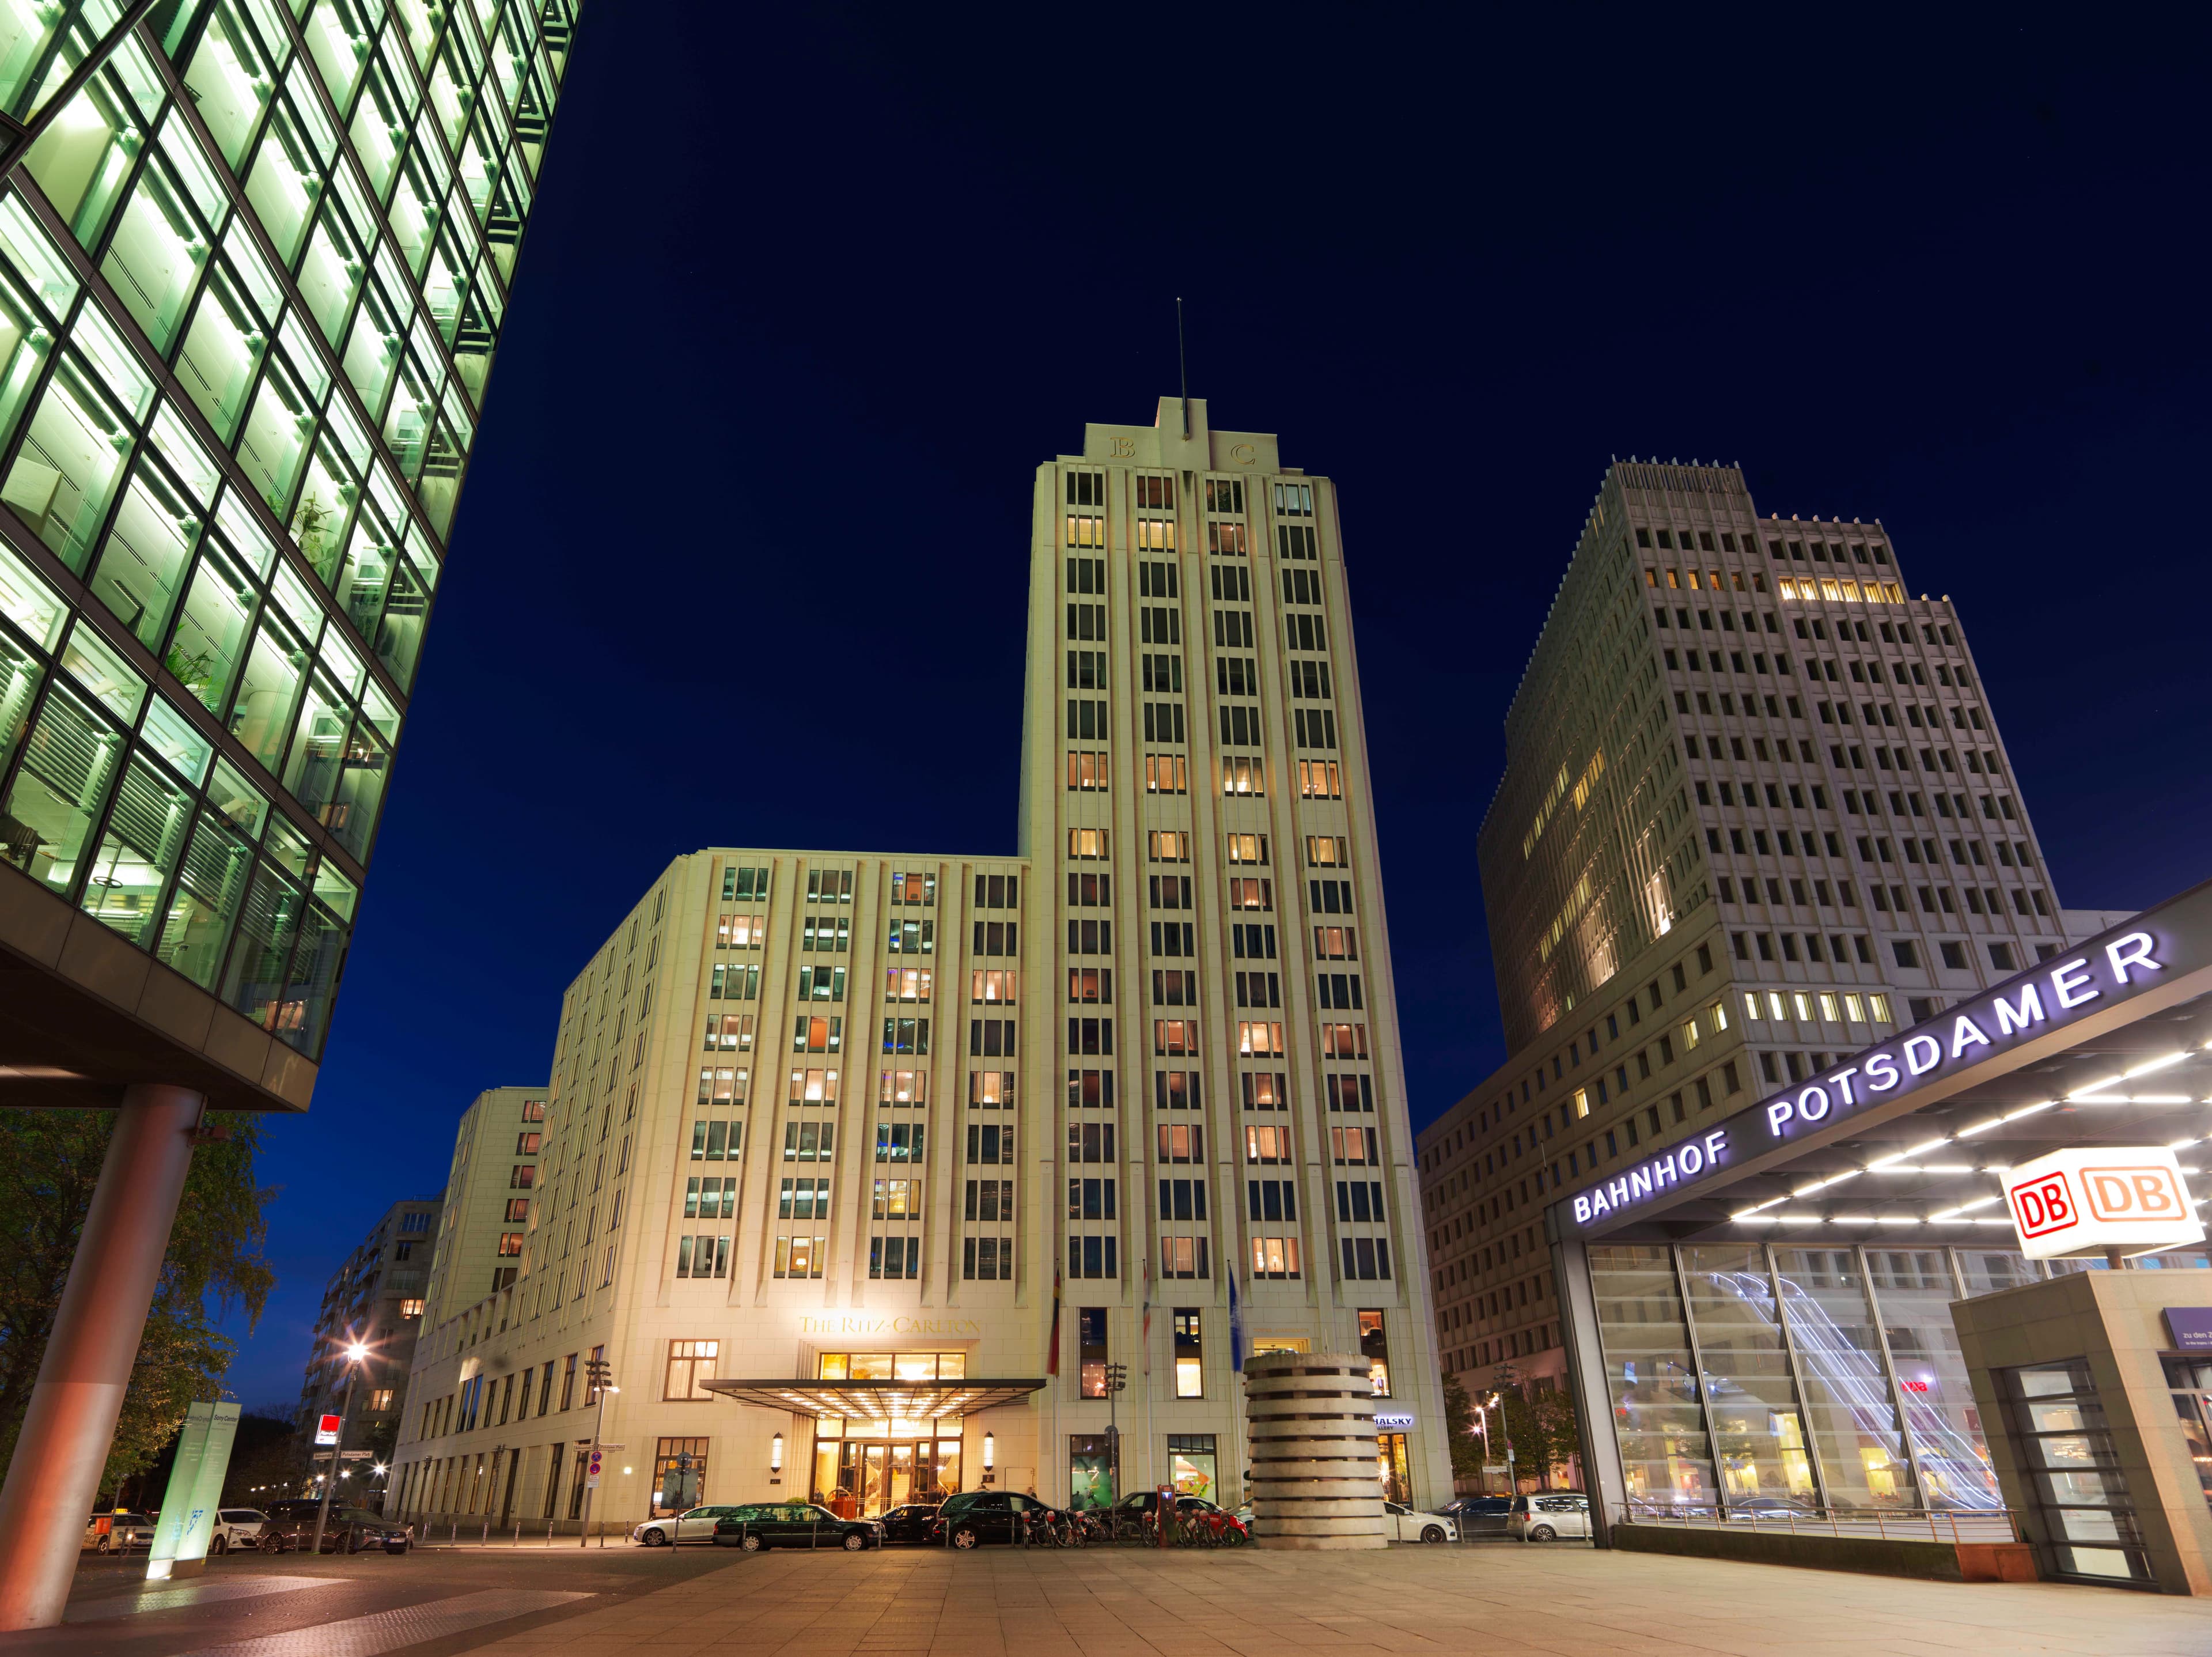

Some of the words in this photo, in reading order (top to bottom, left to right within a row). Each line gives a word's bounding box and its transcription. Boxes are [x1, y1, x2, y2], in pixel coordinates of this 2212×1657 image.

[1110, 437, 1135, 457] B
[1230, 444, 1256, 465] C
[1574, 1130, 1726, 1223] BAHNHOF
[1767, 932, 2162, 1137] POTSDAMER
[2019, 1183, 2068, 1229] DB
[2093, 1175, 2171, 1213] DB
